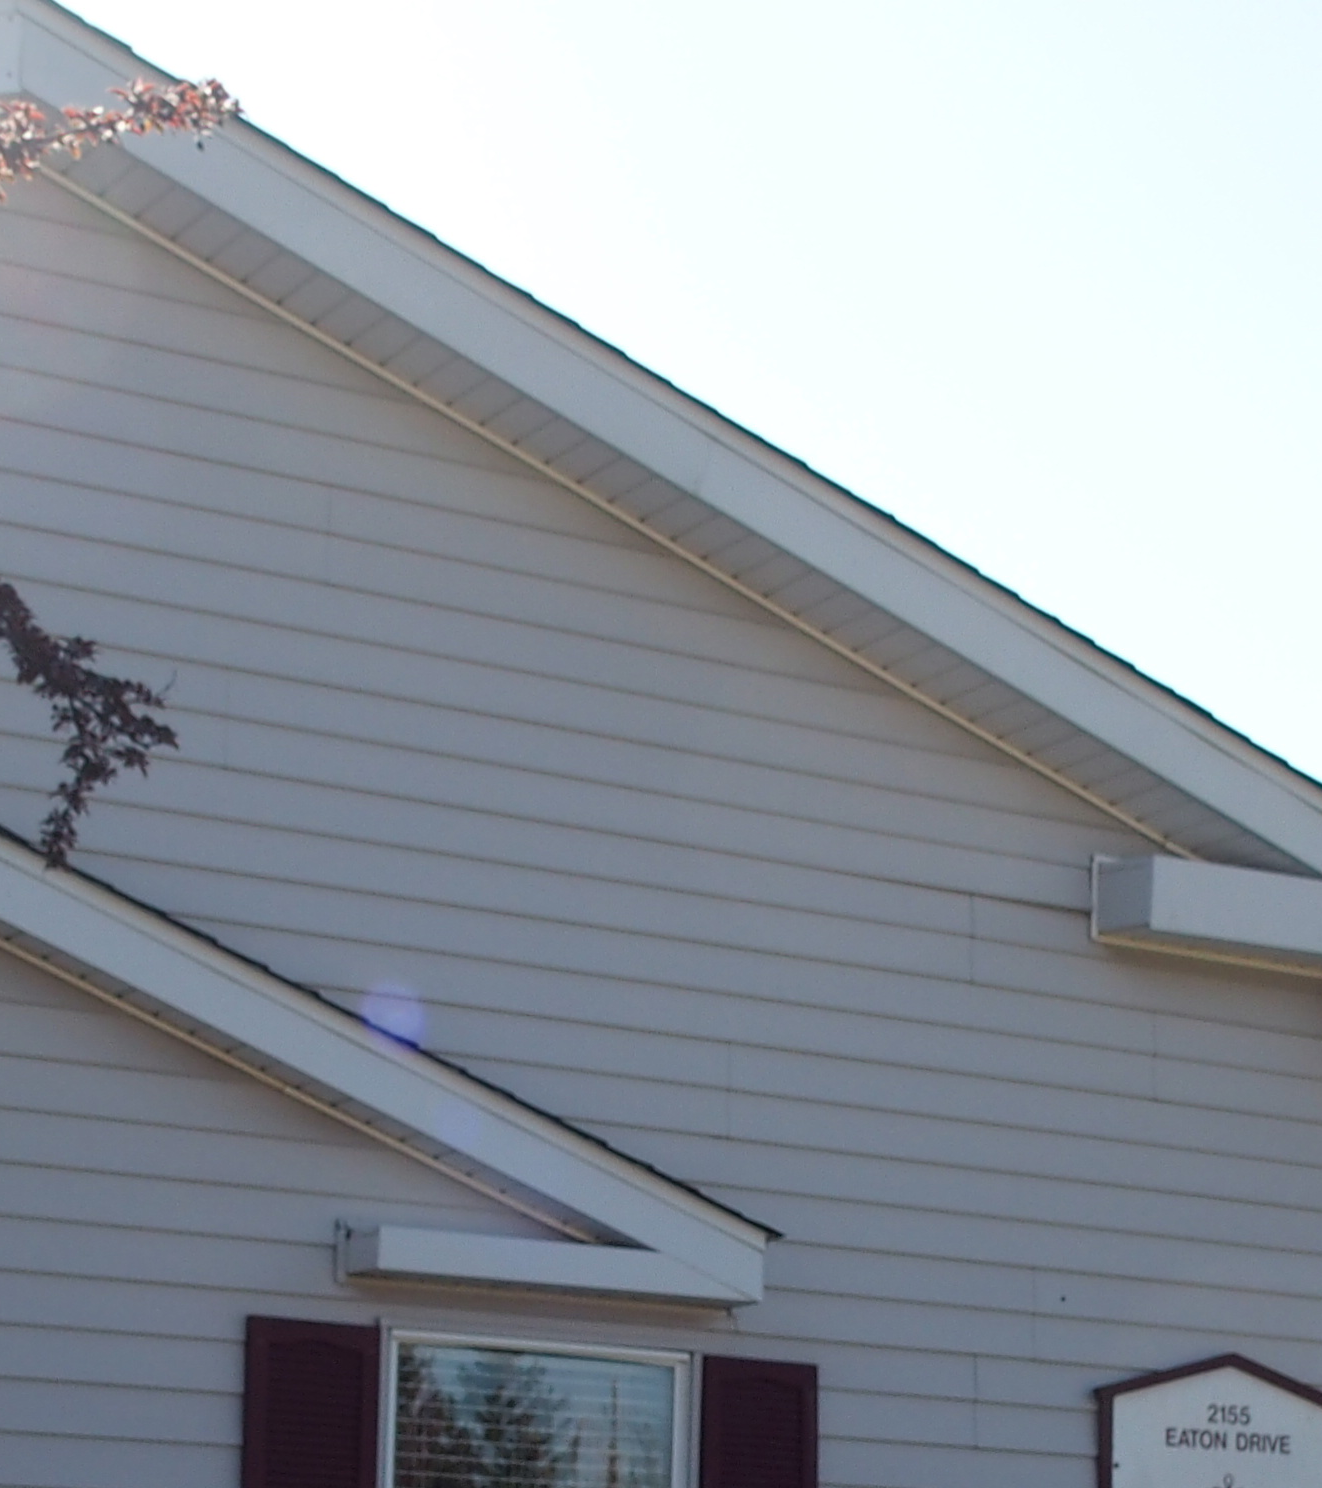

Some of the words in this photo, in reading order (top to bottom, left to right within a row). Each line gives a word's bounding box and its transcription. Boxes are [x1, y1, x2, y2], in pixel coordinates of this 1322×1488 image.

[1207, 1404, 1251, 1425] 2155
[1165, 1427, 1228, 1450] EATON
[1236, 1432, 1291, 1455] DRIVE
